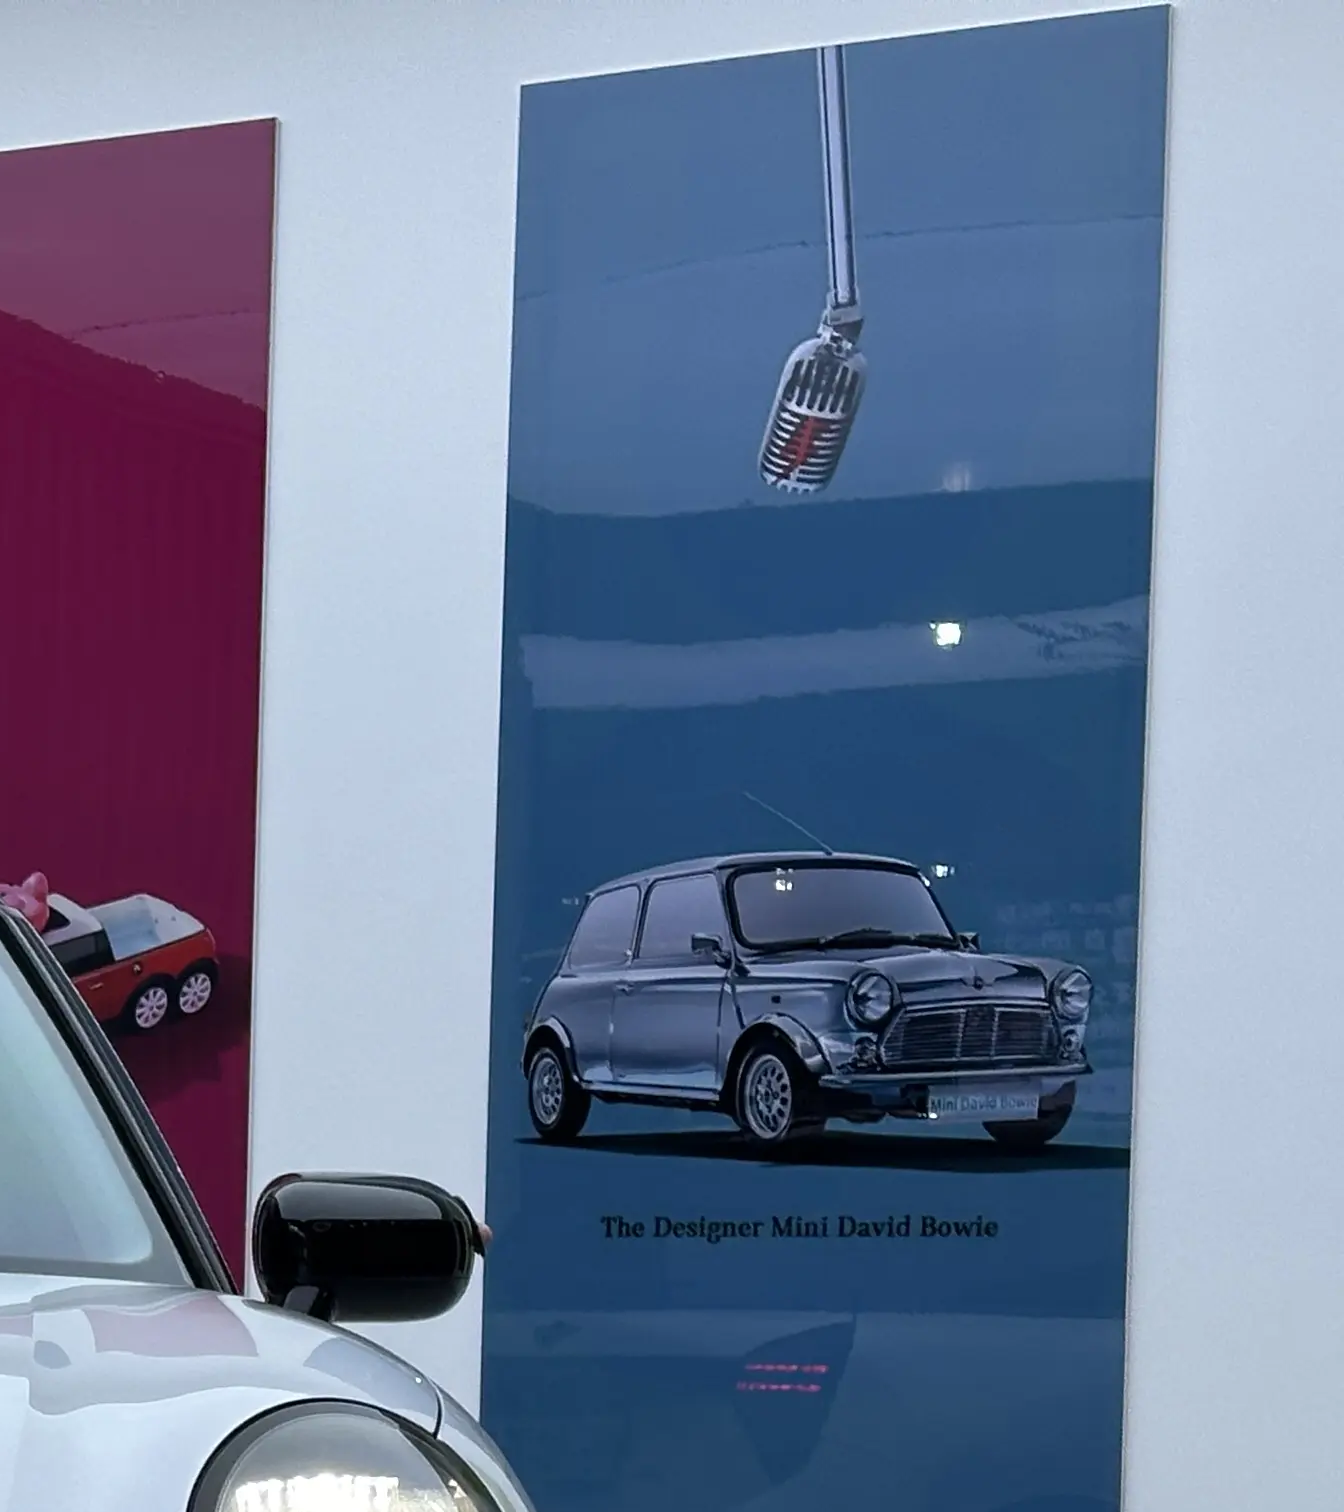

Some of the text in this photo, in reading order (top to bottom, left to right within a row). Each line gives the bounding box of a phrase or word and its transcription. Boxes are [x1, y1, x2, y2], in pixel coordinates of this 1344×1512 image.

[600, 1214, 999, 1244] The Designer Mini David Bowie
